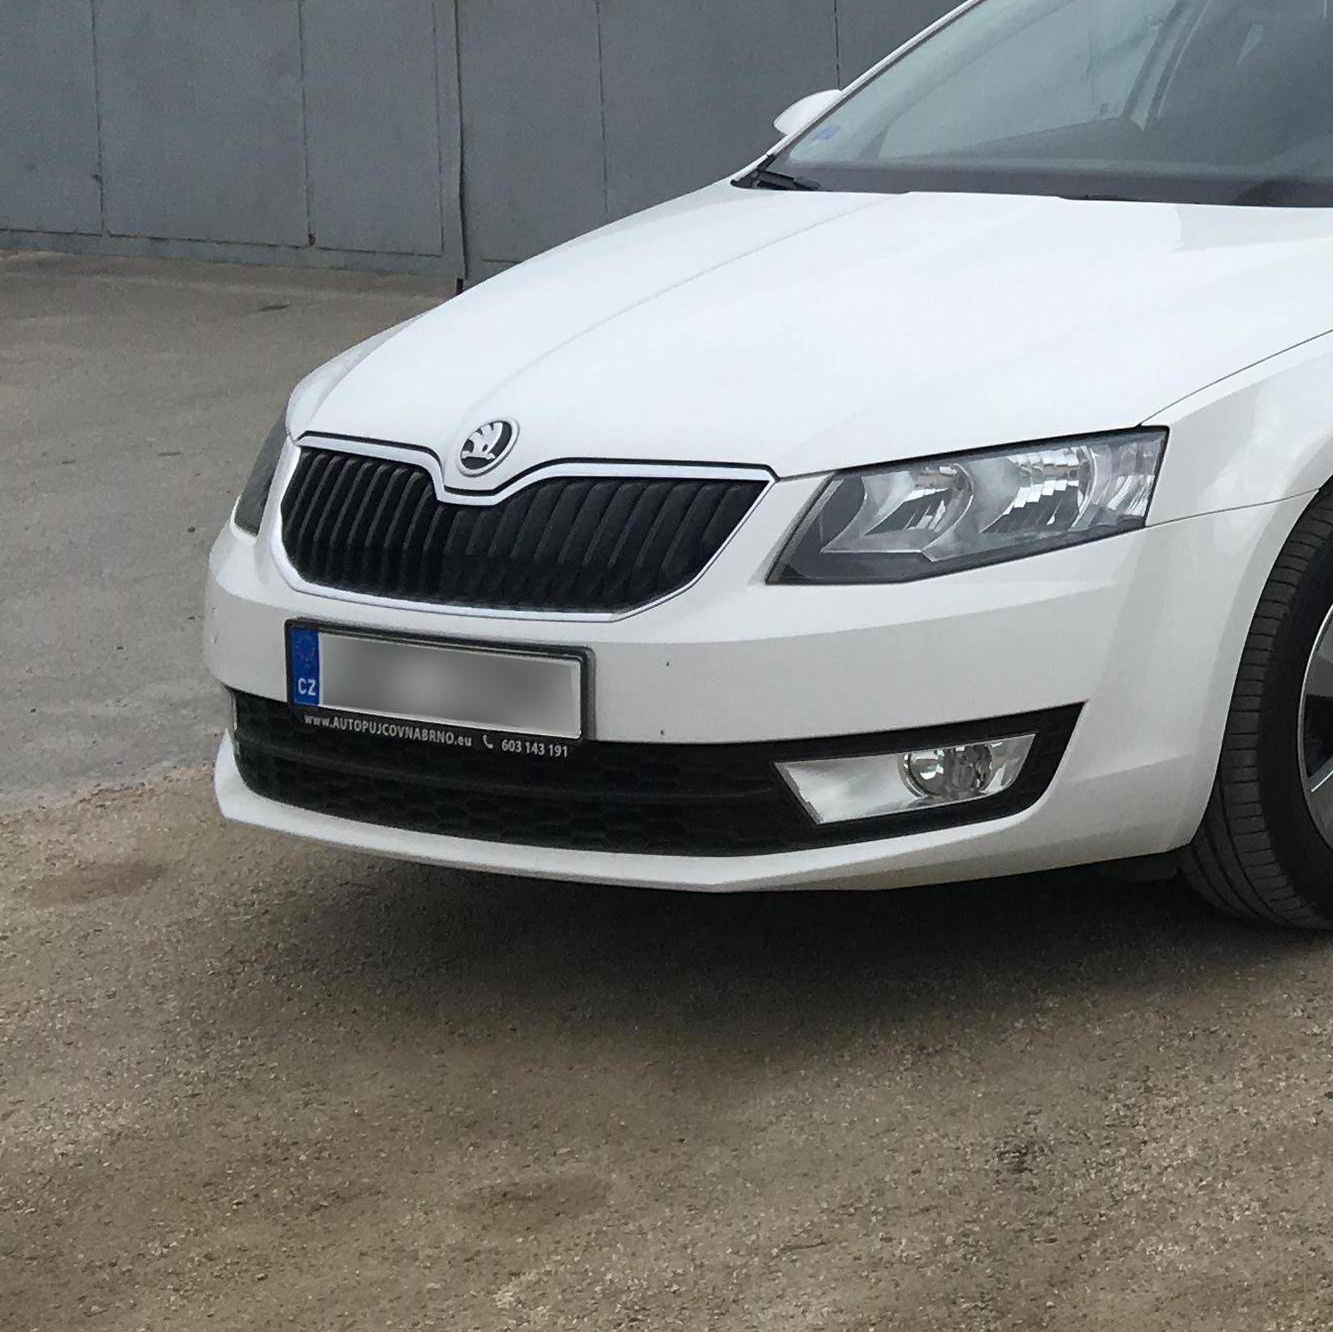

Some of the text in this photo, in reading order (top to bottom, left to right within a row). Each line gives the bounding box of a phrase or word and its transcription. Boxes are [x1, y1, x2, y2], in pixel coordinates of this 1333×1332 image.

[297, 676, 317, 696] CZ
[304, 714, 569, 759] www.AUTOPUJCOVNABRNO.eu 603 143 191
